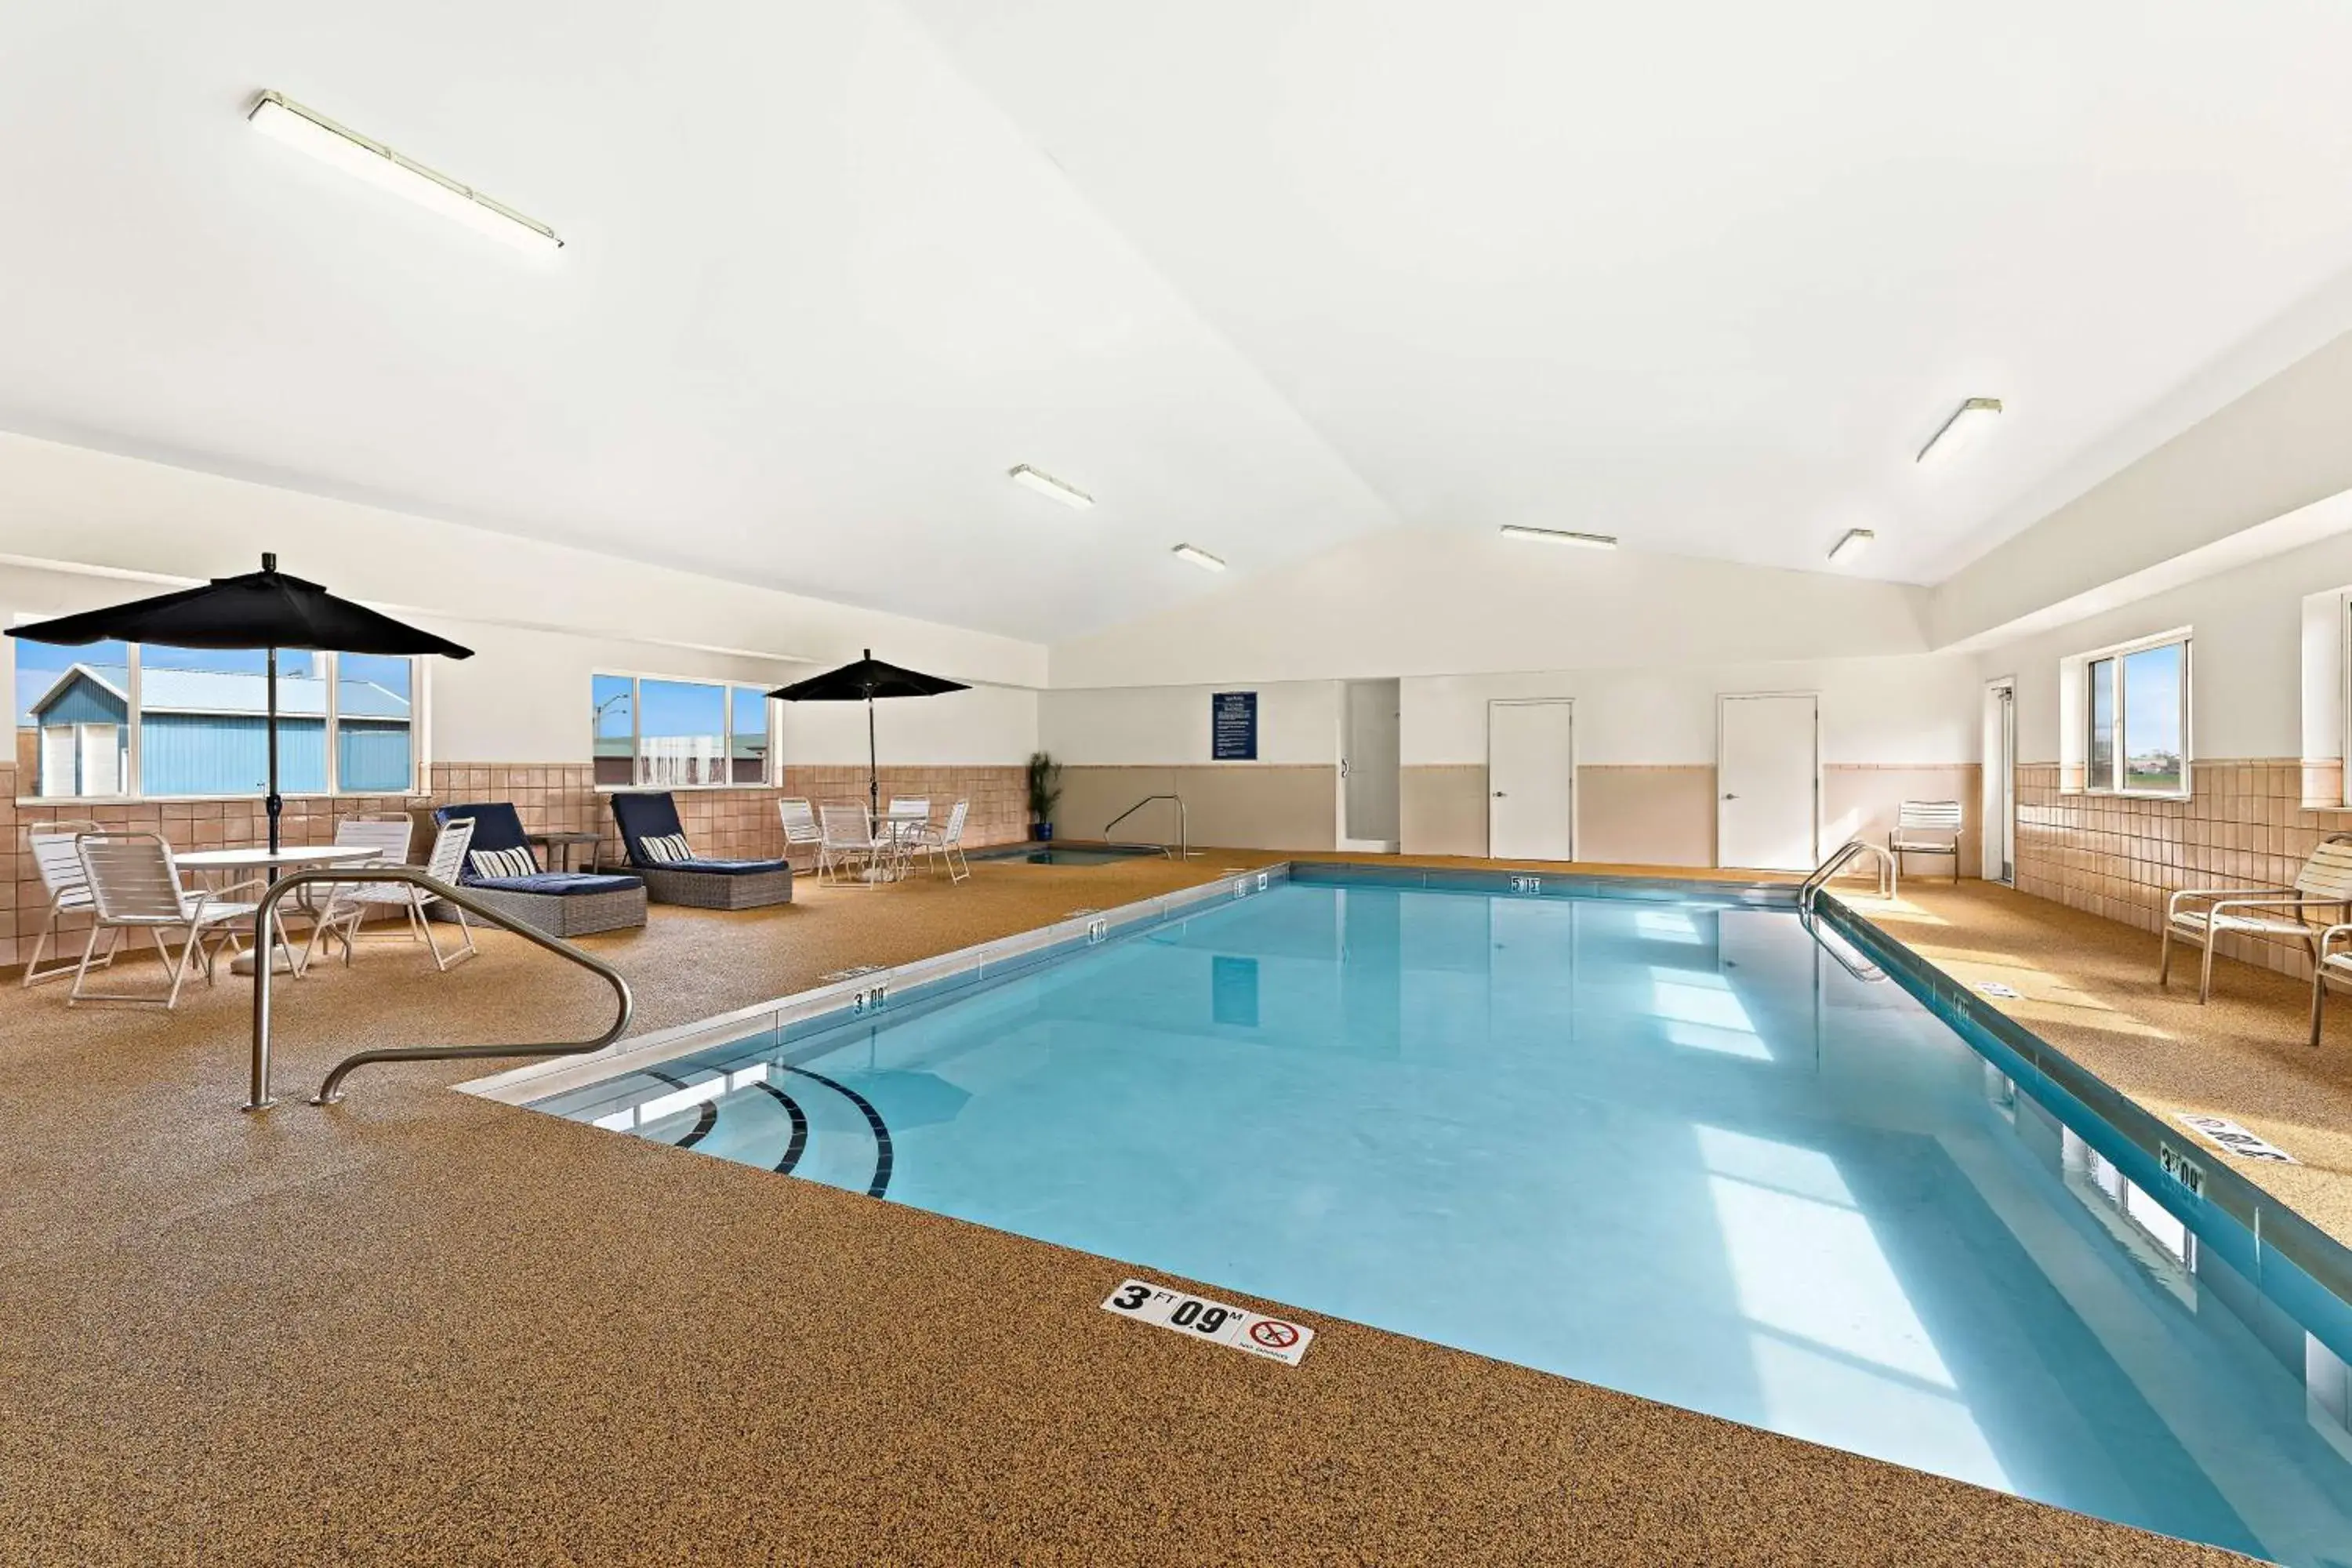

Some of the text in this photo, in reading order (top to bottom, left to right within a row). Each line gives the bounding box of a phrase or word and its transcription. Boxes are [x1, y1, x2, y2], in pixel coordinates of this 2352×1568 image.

[2161, 1148, 2171, 1173] 3
[1112, 1285, 1244, 1333] 3 FT 0.9 M
